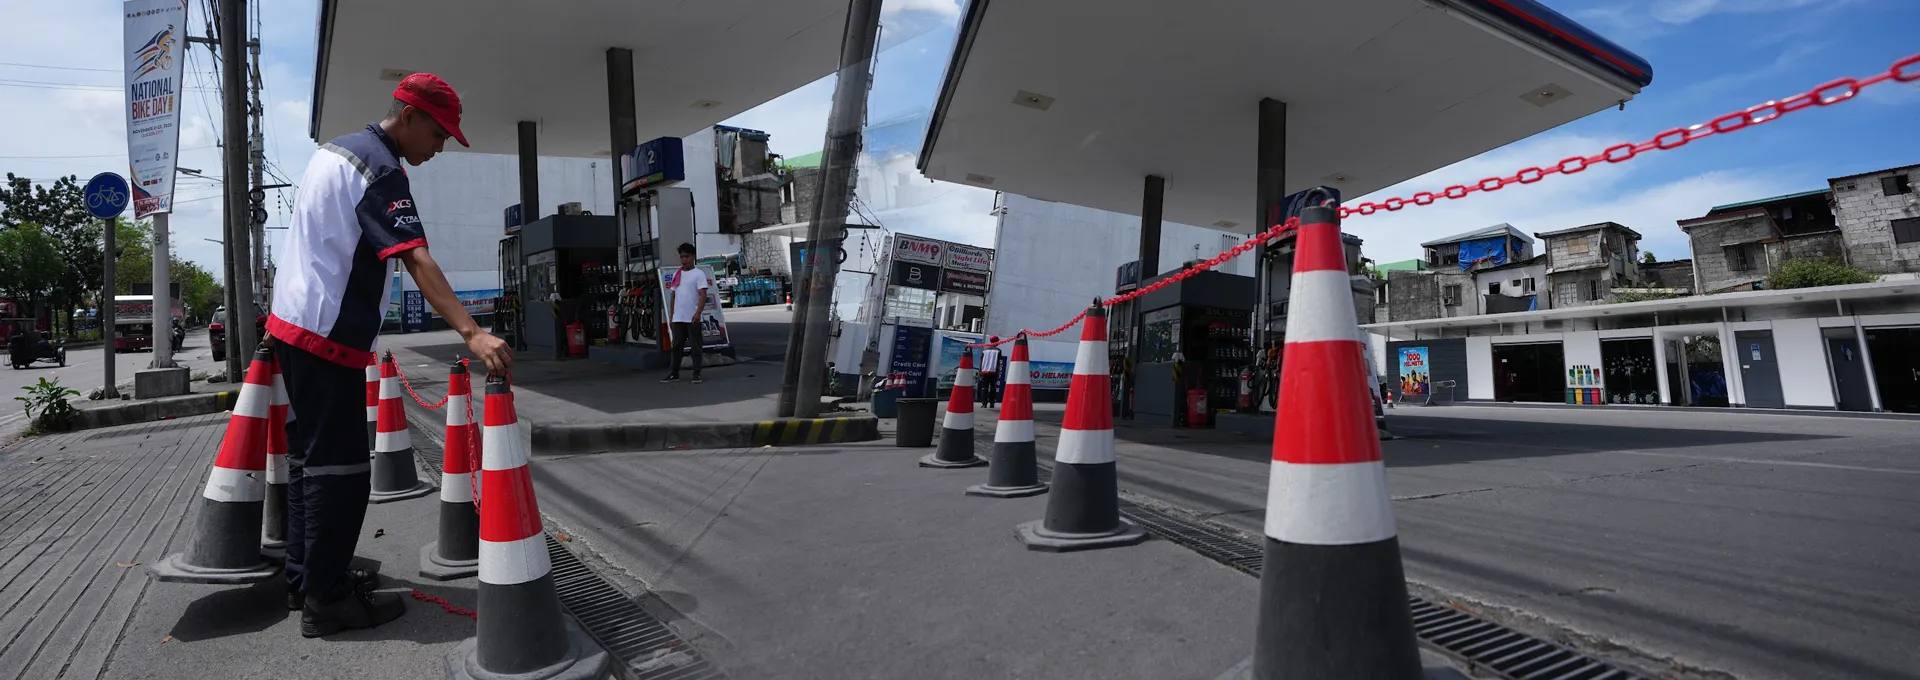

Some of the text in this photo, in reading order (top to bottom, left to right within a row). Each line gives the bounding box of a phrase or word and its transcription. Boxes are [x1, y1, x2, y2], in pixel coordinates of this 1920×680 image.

[131, 77, 174, 101] NATIONAL
[132, 99, 151, 120] BIKE
[152, 96, 168, 116] DAY
[647, 150, 655, 164] 2
[388, 199, 412, 212] XCS
[951, 259, 970, 267] Music
[954, 253, 973, 263] Night
